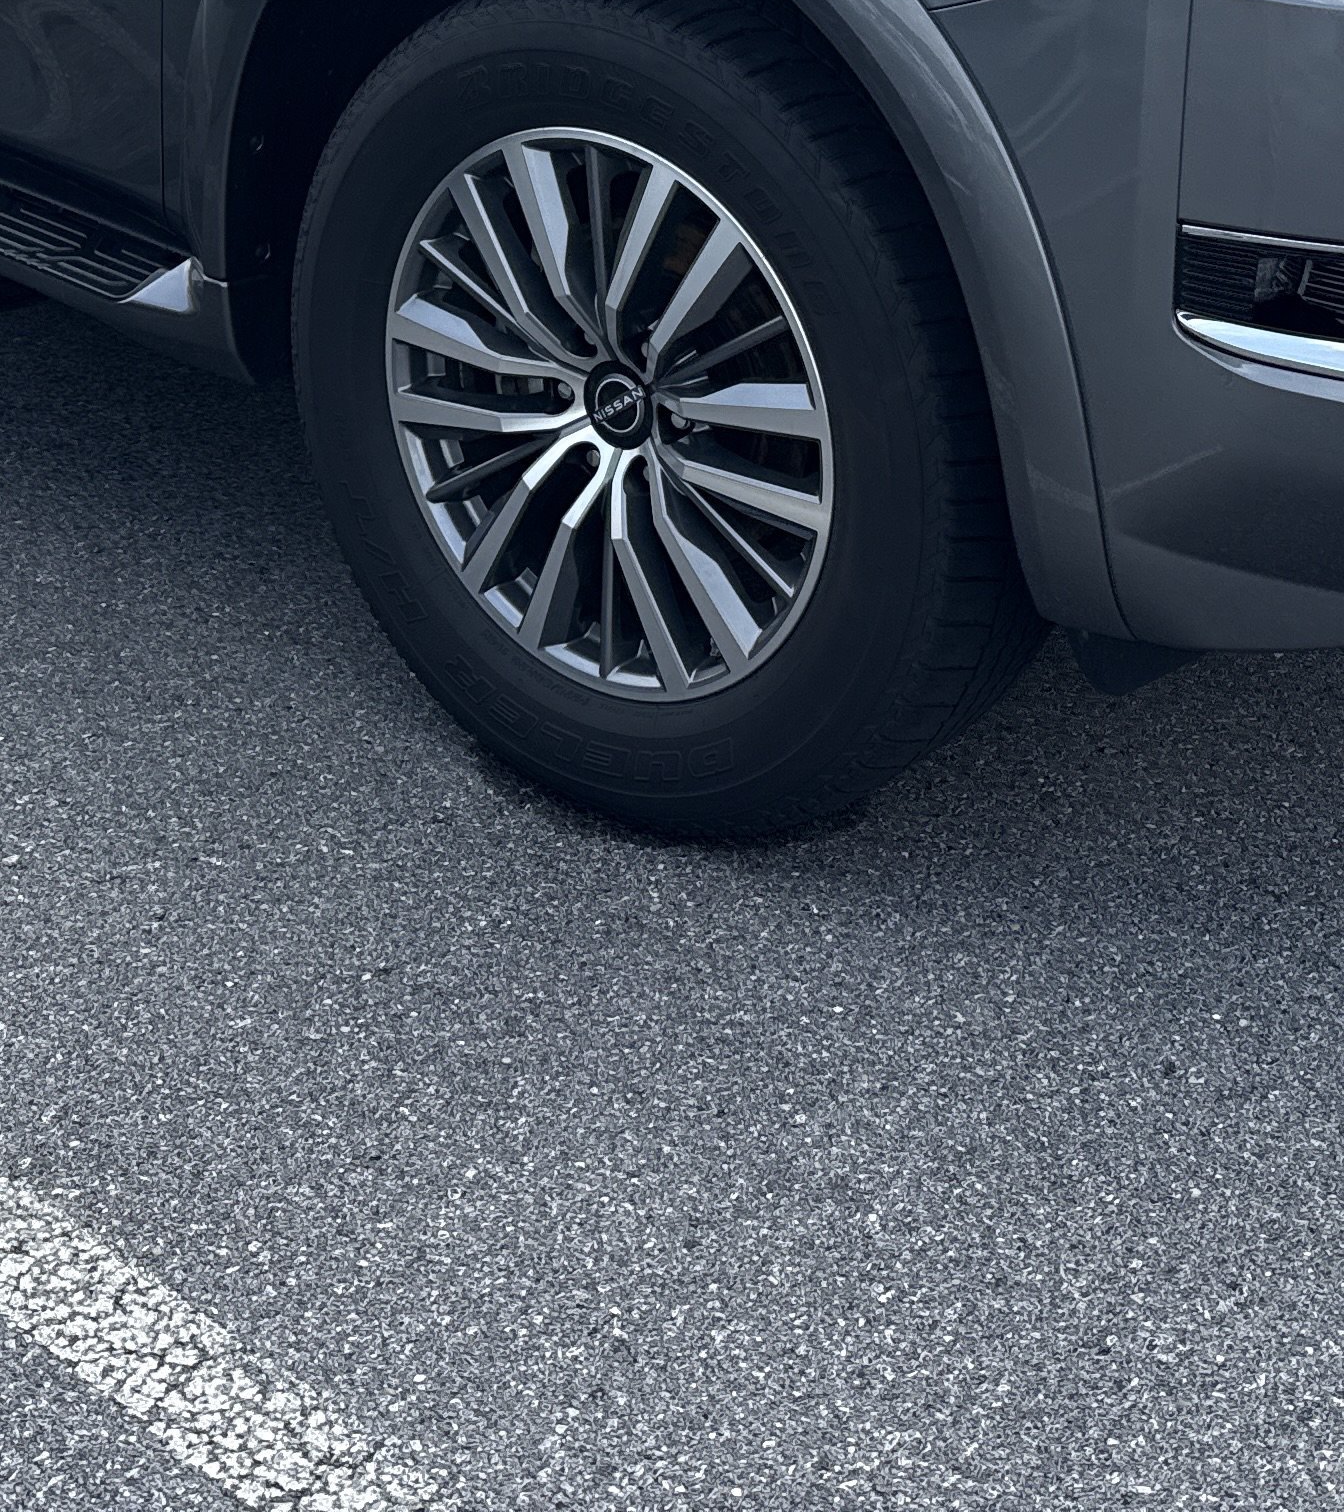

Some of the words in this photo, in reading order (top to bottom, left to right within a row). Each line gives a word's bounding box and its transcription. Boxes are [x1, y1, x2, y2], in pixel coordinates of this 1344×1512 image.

[455, 60, 839, 317] BRIDGESTONE
[592, 386, 645, 423] NISSAN
[443, 653, 735, 782] DUELER
